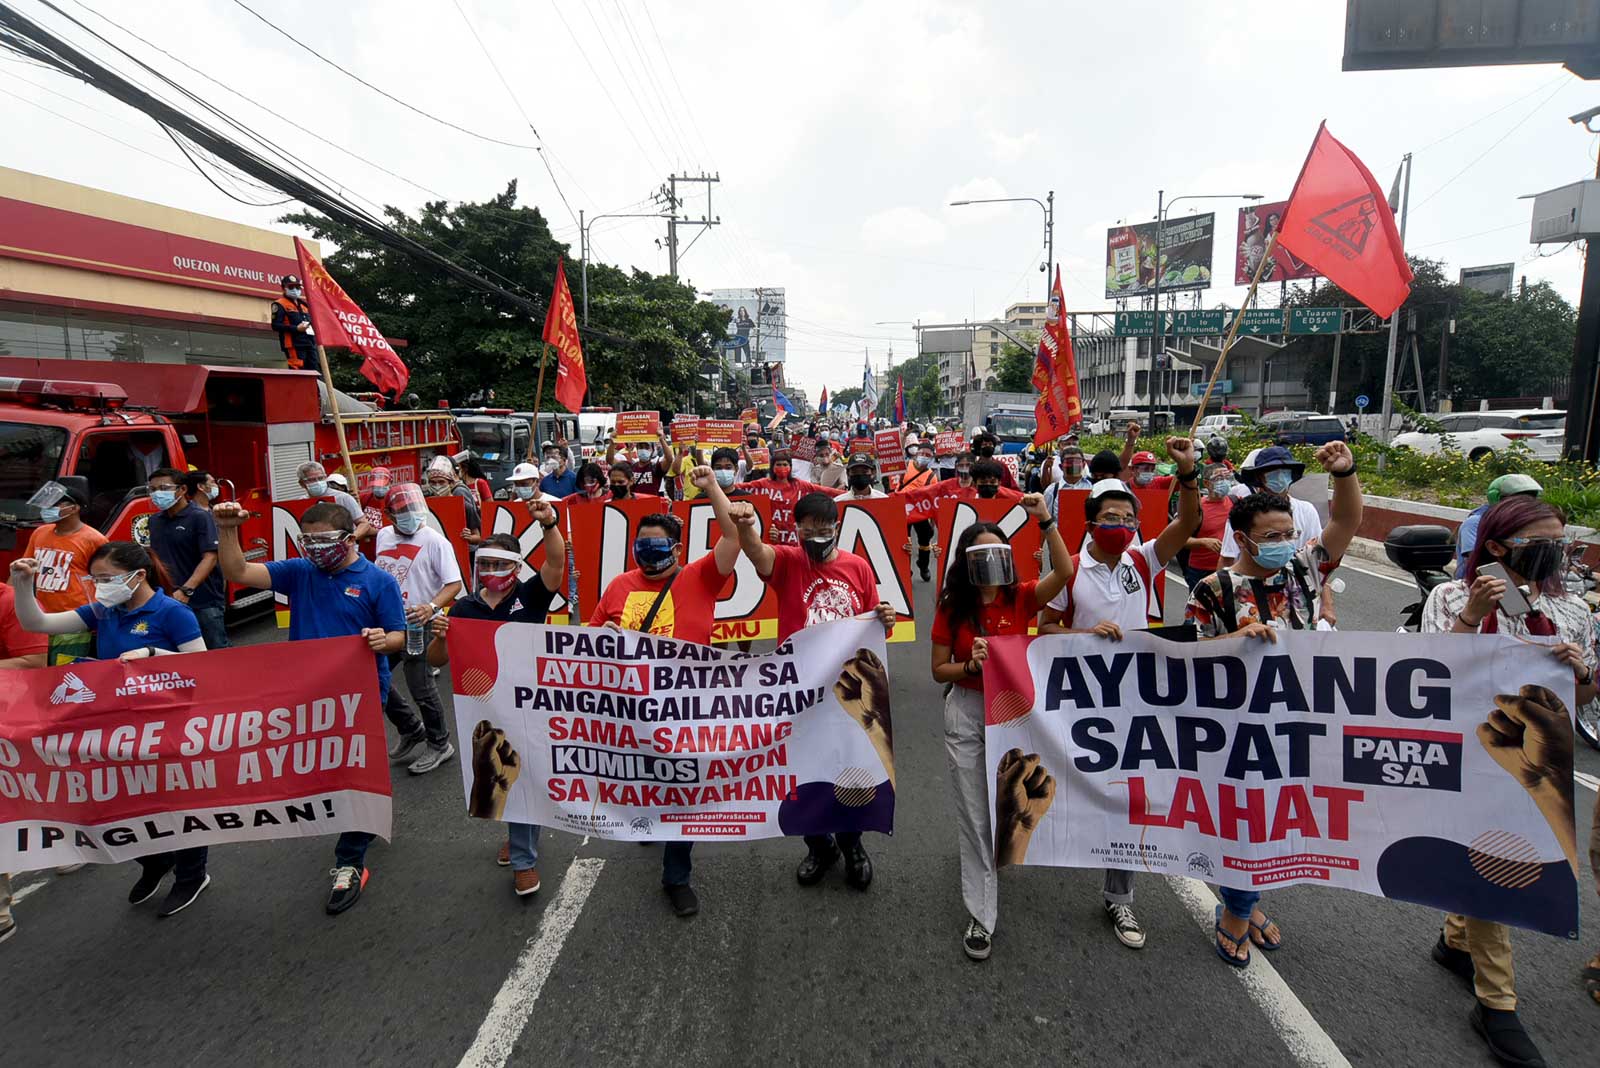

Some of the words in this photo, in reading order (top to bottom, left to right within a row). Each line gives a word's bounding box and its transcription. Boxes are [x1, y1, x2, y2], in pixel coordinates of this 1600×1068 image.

[1109, 234, 1129, 244] NEW!
[173, 255, 220, 273] QUEZON
[224, 265, 265, 282] AVENUE
[771, 509, 792, 522] AT
[826, 577, 849, 590] MAYO
[545, 631, 721, 662] IPAGLABAN
[116, 678, 196, 697] NETWORK
[125, 671, 181, 686] AYUDA
[542, 660, 644, 692] AYUDA
[653, 663, 749, 690] BATAY
[758, 661, 800, 687] SA
[1045, 652, 1452, 721] AYUDANG
[514, 686, 826, 722] PANGANGAILANGAN!
[32, 721, 165, 768] WAGE
[180, 692, 363, 757] SUBSIDY
[548, 716, 793, 753] SAMA-SAMANG
[237, 734, 367, 786] AYUDA
[1070, 715, 1327, 781] SAPAT
[1353, 738, 1449, 766] PARA
[555, 747, 698, 782] KUMILOS
[706, 743, 787, 780] AYON
[1381, 763, 1430, 786] SA
[547, 778, 590, 803] SA
[600, 774, 798, 807] KAKAYAHAN!
[567, 813, 589, 821] MAYO
[1127, 776, 1365, 844] LAHAT
[17, 798, 336, 852] IPAGLABAN!
[580, 820, 625, 828] MANGGAGAWA
[686, 826, 741, 834] #MAKIBAKA
[1090, 847, 1111, 856] ARAW
[1113, 849, 1124, 857] NG
[1126, 850, 1180, 862] MANGGAGAWA
[1110, 842, 1136, 850] MAYO
[1138, 843, 1158, 851] UNO
[1231, 856, 1351, 869] #AyudangSapatParaSaLahat
[1259, 869, 1322, 883] #MAKIBAKA
